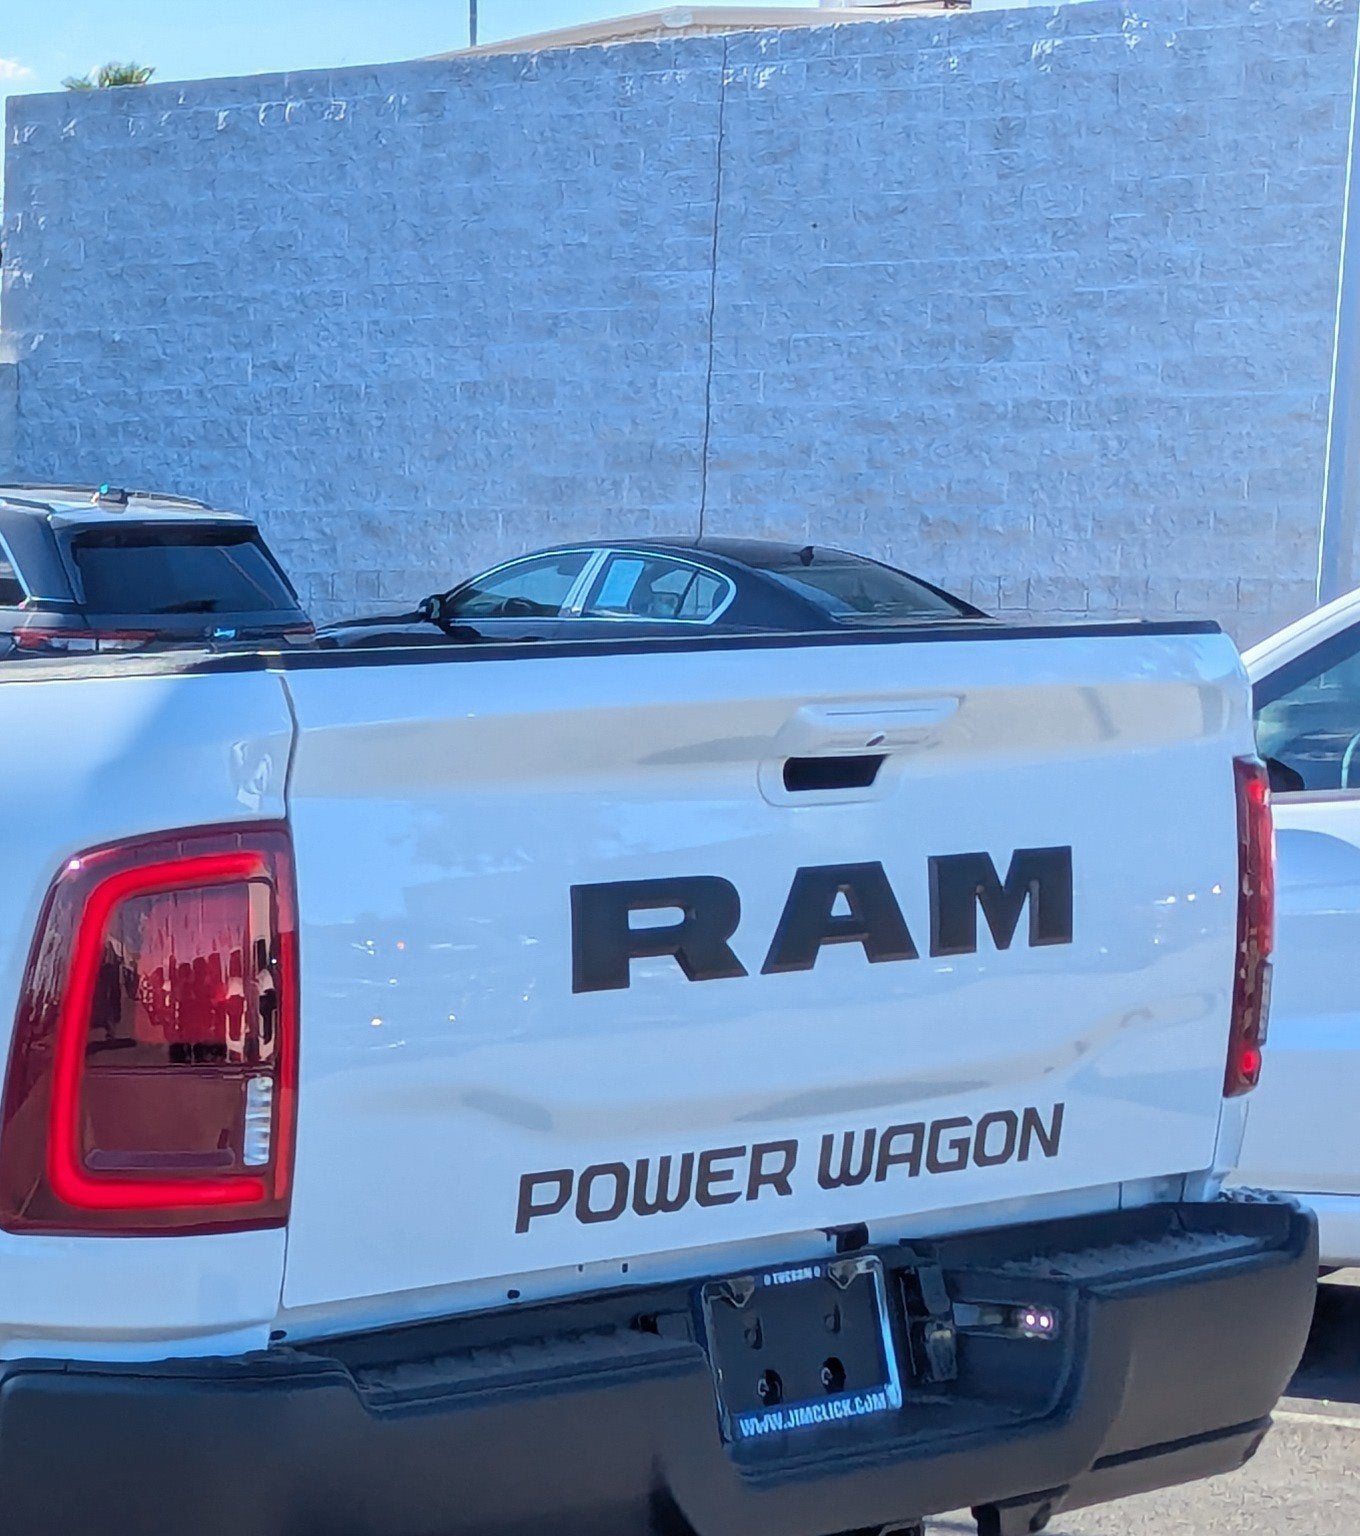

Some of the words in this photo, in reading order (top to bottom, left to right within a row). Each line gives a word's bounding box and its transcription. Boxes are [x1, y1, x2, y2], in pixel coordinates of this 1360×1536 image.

[569, 845, 1073, 994] RAM
[514, 1139, 799, 1234] POWER
[816, 1102, 1066, 1190] WAGON
